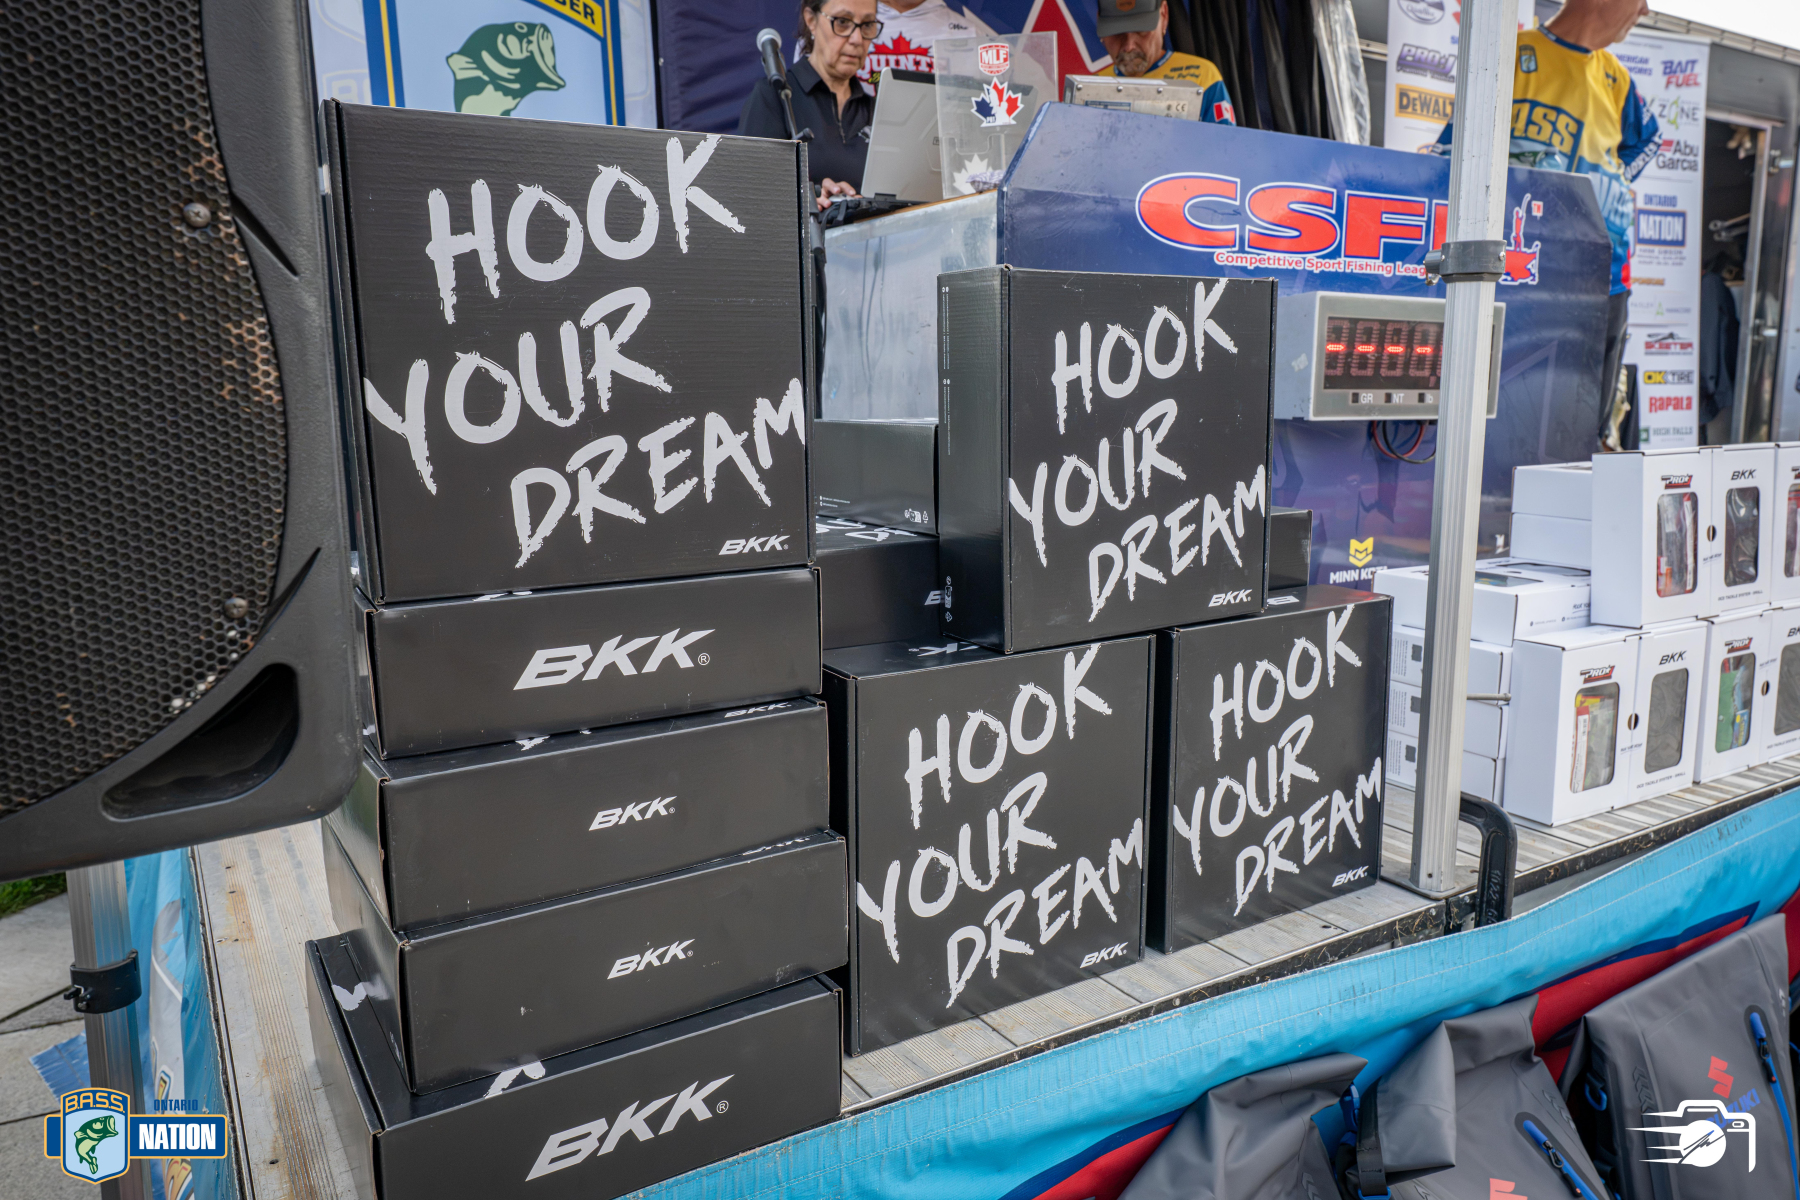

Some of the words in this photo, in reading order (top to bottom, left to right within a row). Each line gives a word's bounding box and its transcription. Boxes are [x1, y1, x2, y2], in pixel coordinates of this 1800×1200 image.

[981, 49, 1006, 65] MLF
[1662, 60, 1699, 75] BAIT
[1664, 74, 1701, 89] FUEL
[1136, 172, 1450, 261] CSF
[1656, 153, 1699, 171] Garcia
[426, 135, 746, 324] HOOK
[1214, 251, 1303, 269] Competitive
[1305, 257, 1347, 273] Sport
[1347, 260, 1393, 275] Fishing
[1396, 263, 1427, 277] Leag
[1638, 213, 1685, 241] NATION
[363, 286, 673, 495] YOUR
[1051, 278, 1238, 434] HOOK
[1360, 393, 1374, 403] GR
[1393, 393, 1404, 403] NT
[510, 378, 805, 568] DREAM
[1009, 398, 1186, 567] YOUR
[1731, 469, 1757, 480] BKK
[1088, 464, 1266, 622] DREAM
[1329, 569, 1360, 584] MINN
[1210, 604, 1362, 761] HOOK
[1659, 651, 1687, 665] BKK
[904, 643, 1112, 829] HOOK
[1173, 714, 1319, 876] YOUR
[857, 772, 1057, 963] YOUR
[1234, 757, 1382, 917] DREAM
[946, 818, 1143, 1008] DREAM
[1706, 1087, 1761, 1129] UZUKI
